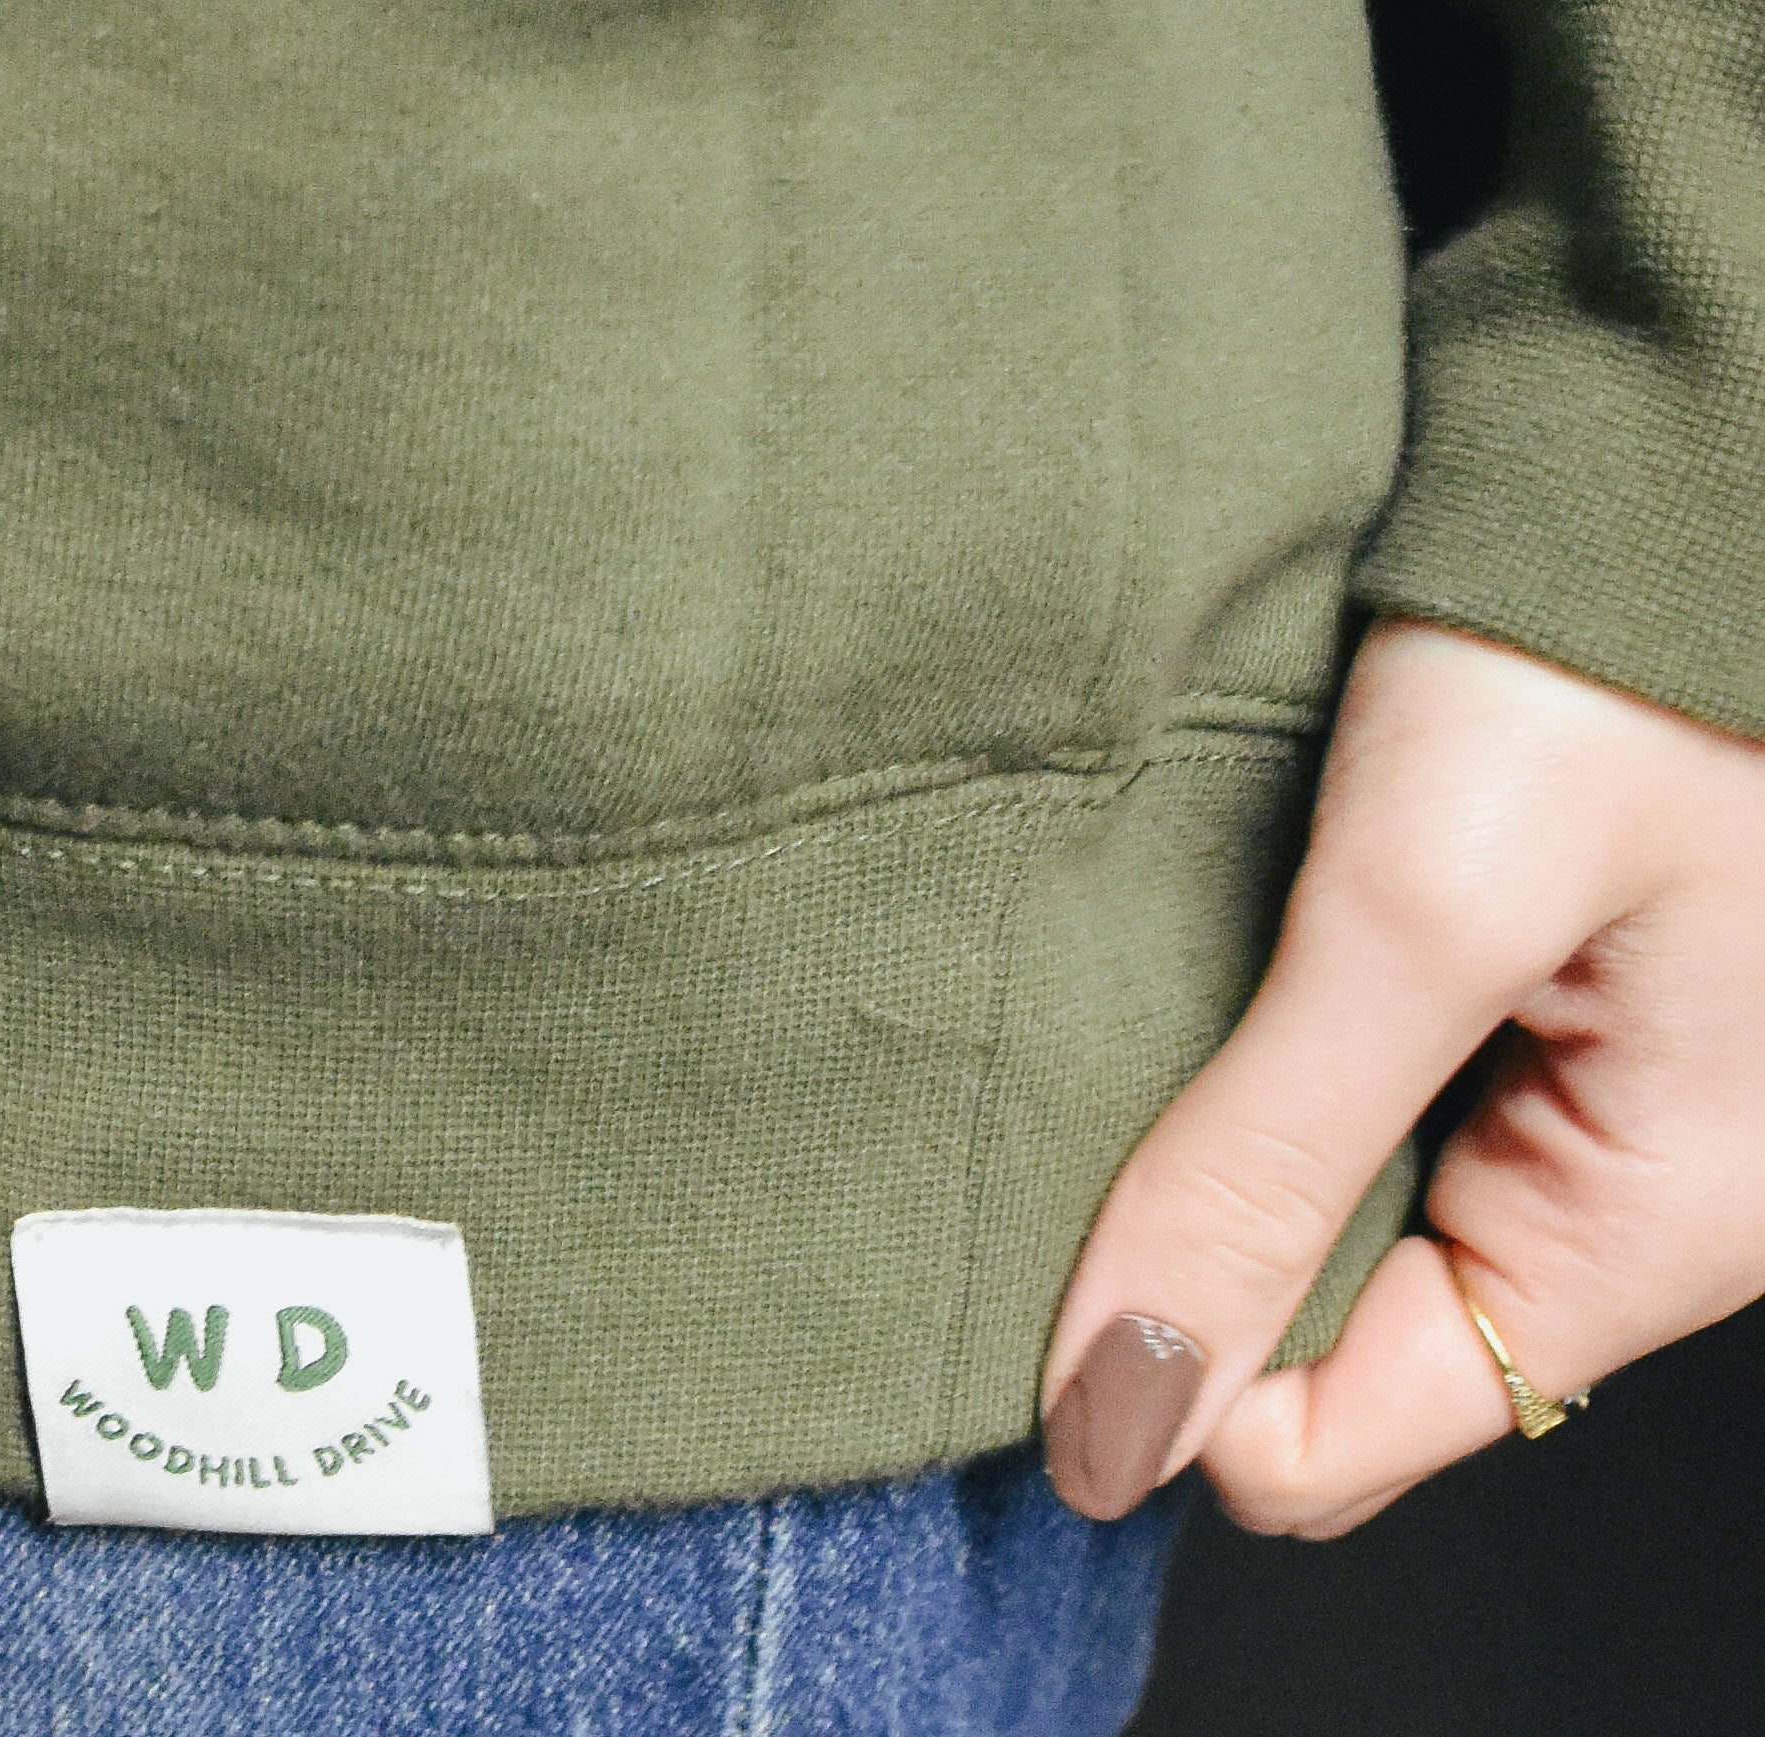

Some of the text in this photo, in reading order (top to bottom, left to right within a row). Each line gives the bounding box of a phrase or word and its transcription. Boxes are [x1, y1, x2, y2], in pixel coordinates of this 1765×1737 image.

[125, 1304, 349, 1393] W D
[59, 1378, 433, 1489] WOODHILL DRIVE
